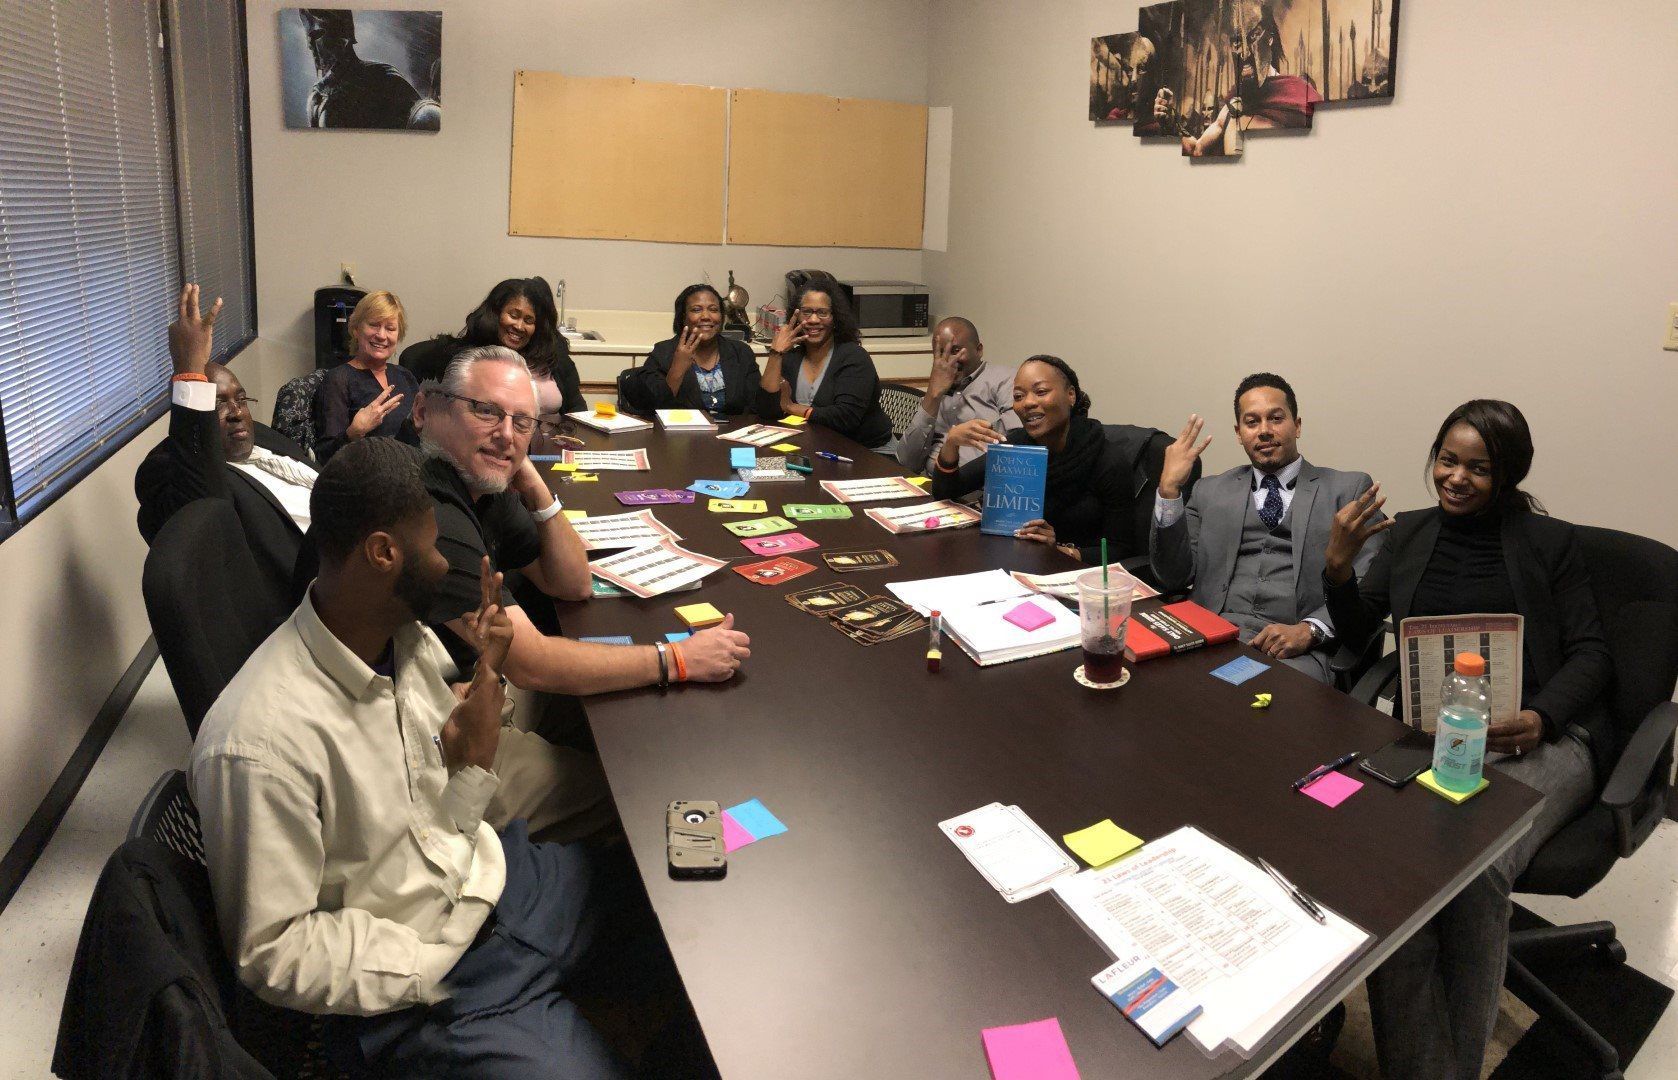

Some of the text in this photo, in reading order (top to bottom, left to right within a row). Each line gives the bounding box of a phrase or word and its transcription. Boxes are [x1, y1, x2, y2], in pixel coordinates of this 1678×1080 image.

[996, 454, 1023, 465] JOHN
[991, 464, 1040, 477] MAXWELL
[1004, 483, 1025, 495] NO
[986, 493, 1041, 512] LIMITS
[1139, 847, 1177, 867] Leadership
[1098, 955, 1142, 984] LAFLEUR
